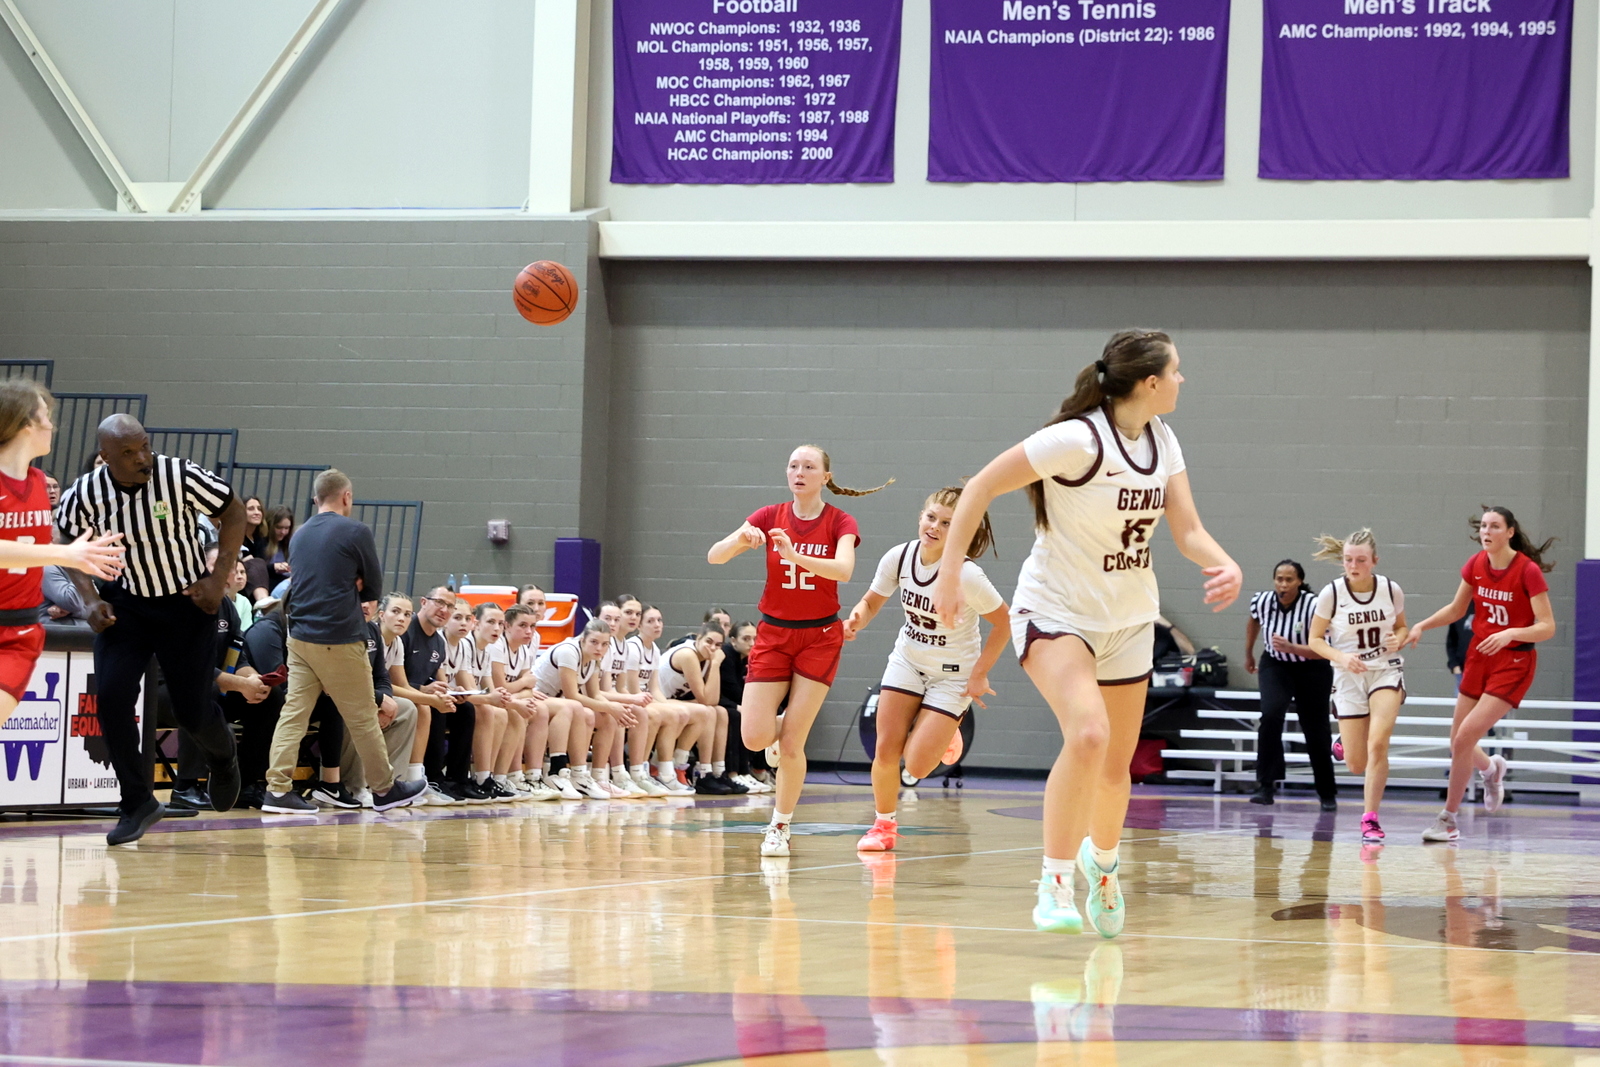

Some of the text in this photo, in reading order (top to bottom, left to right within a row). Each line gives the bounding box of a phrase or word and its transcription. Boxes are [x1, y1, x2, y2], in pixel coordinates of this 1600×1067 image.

[713, 0, 798, 14] Football
[1080, 0, 1157, 21] Tennis
[1428, 0, 1492, 14] Track
[650, 19, 861, 38] NWOC Champions: 1932, 1936
[944, 26, 1215, 47] NAIA Champions (District 22): 1986
[1279, 20, 1556, 42] AMC Champions: 1992, 1994, 1995
[636, 37, 873, 56] MOL Champions: 1951, 1956, 1957,
[698, 56, 809, 73] 1958, 1959, 1960
[656, 74, 851, 92] MOC Champions: 1962, 1967
[669, 92, 836, 109] HBCC Champions: 1972
[634, 109, 870, 128] NAIA National Playoffs: 1987, 1988
[673, 128, 829, 145] AMC Champions: 1994
[667, 146, 834, 163] HCAC Champions: 2000
[0, 510, 53, 529] BELLEVU
[780, 559, 816, 590] 32
[1477, 585, 1514, 602] BELLEVUE
[1348, 608, 1387, 625] GENOA
[1482, 601, 1509, 626] 30
[1356, 626, 1381, 649] 10
[67, 777, 118, 789] URBANA LAKEVIEW
